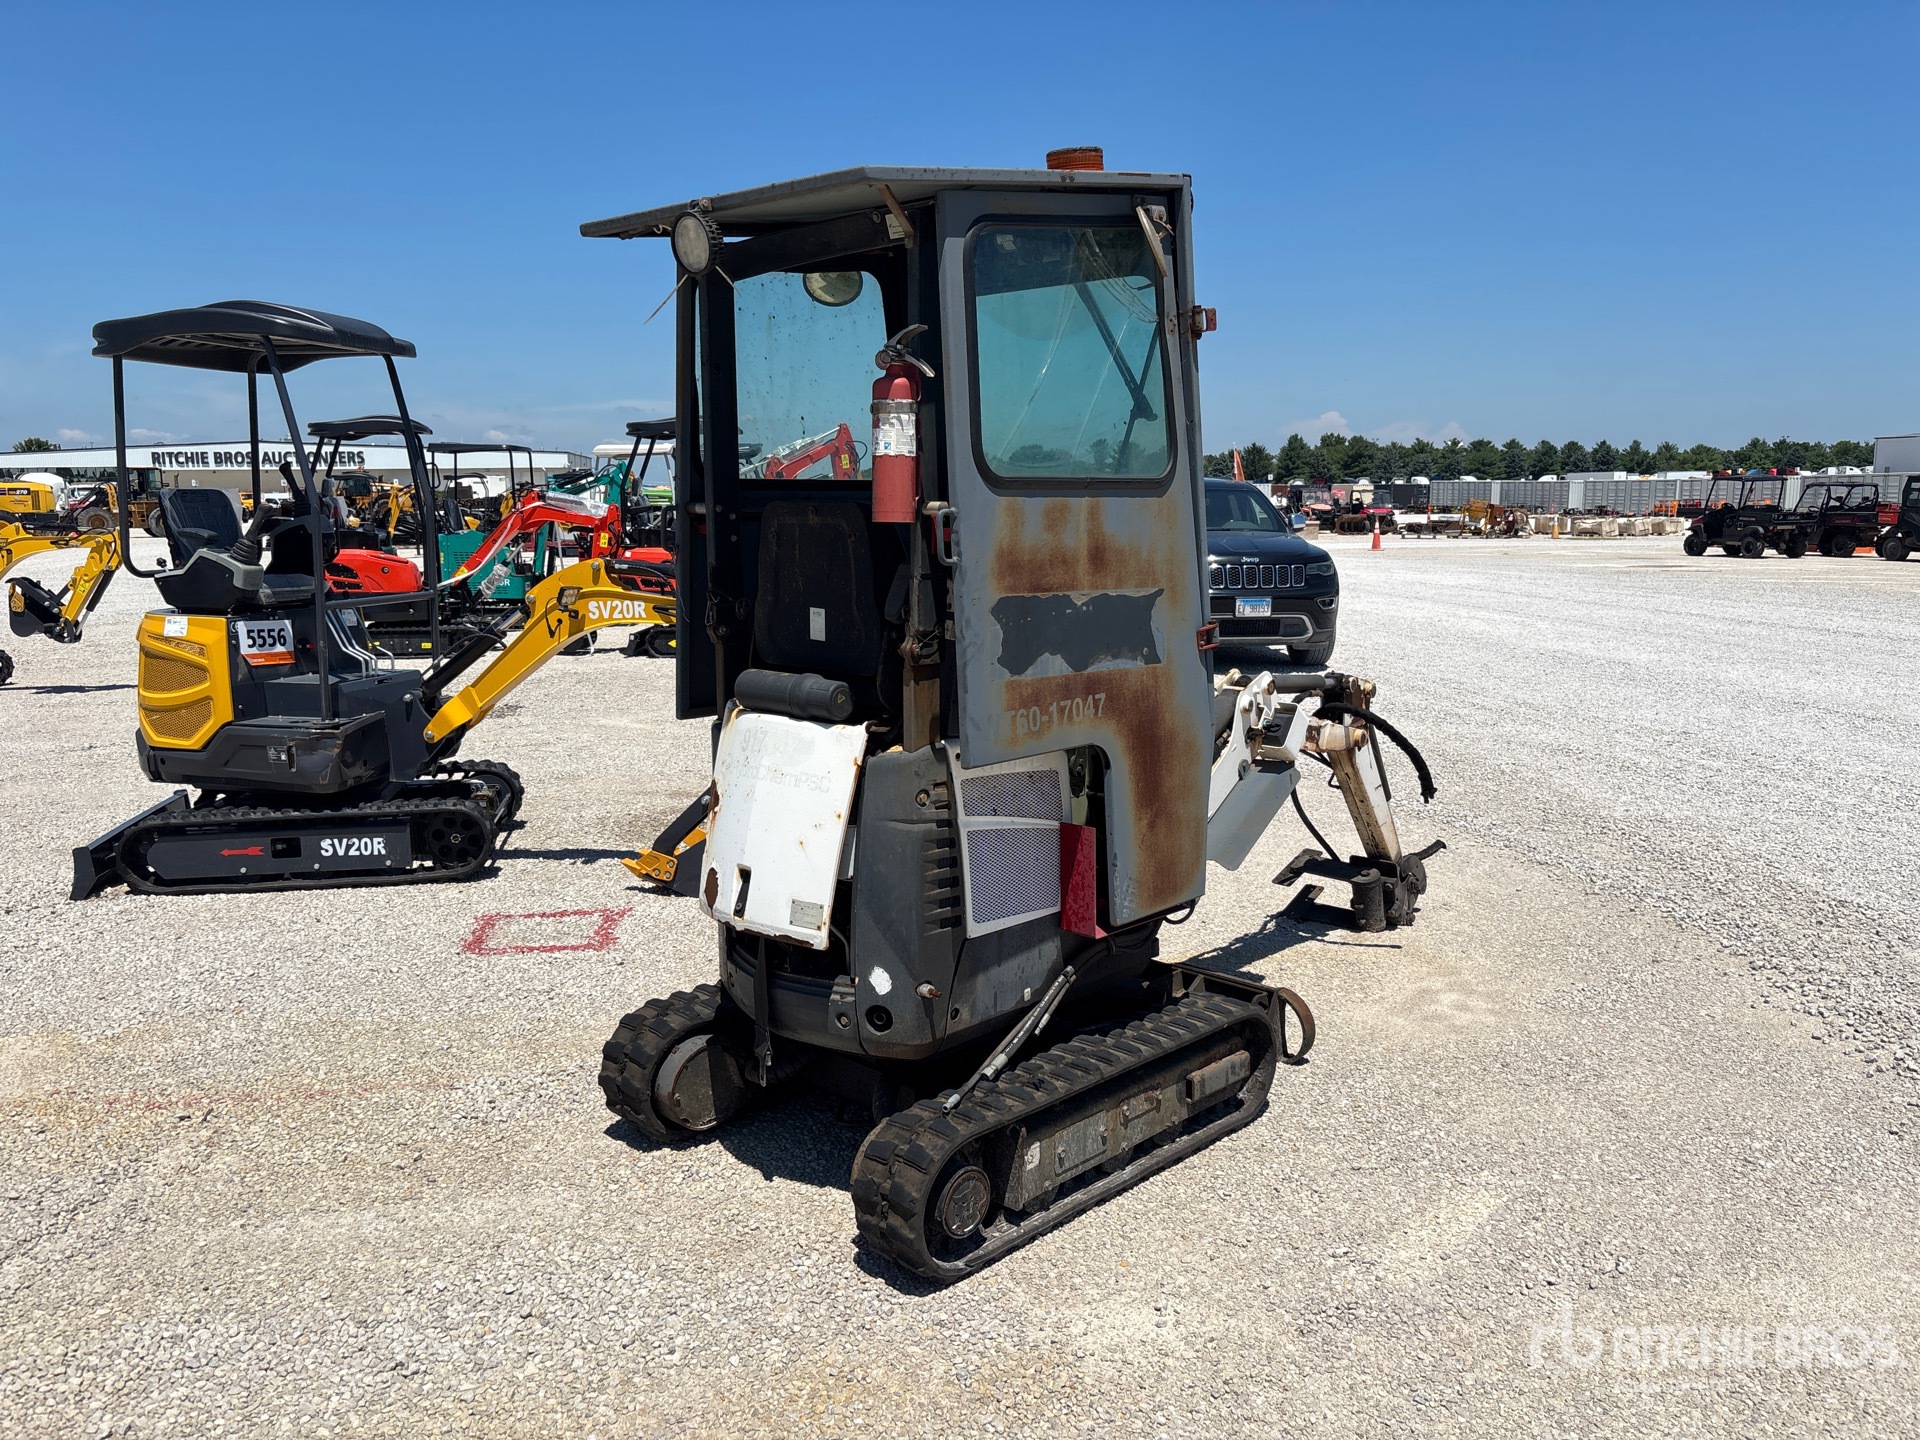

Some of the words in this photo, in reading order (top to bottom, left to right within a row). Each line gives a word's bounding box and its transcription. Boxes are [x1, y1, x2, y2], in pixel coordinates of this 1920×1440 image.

[151, 451, 211, 467] RITCHIE
[261, 451, 366, 468] AUCTONEERS
[588, 600, 647, 620] SV20R
[247, 628, 287, 649] 5556
[320, 837, 387, 857] SV20R
